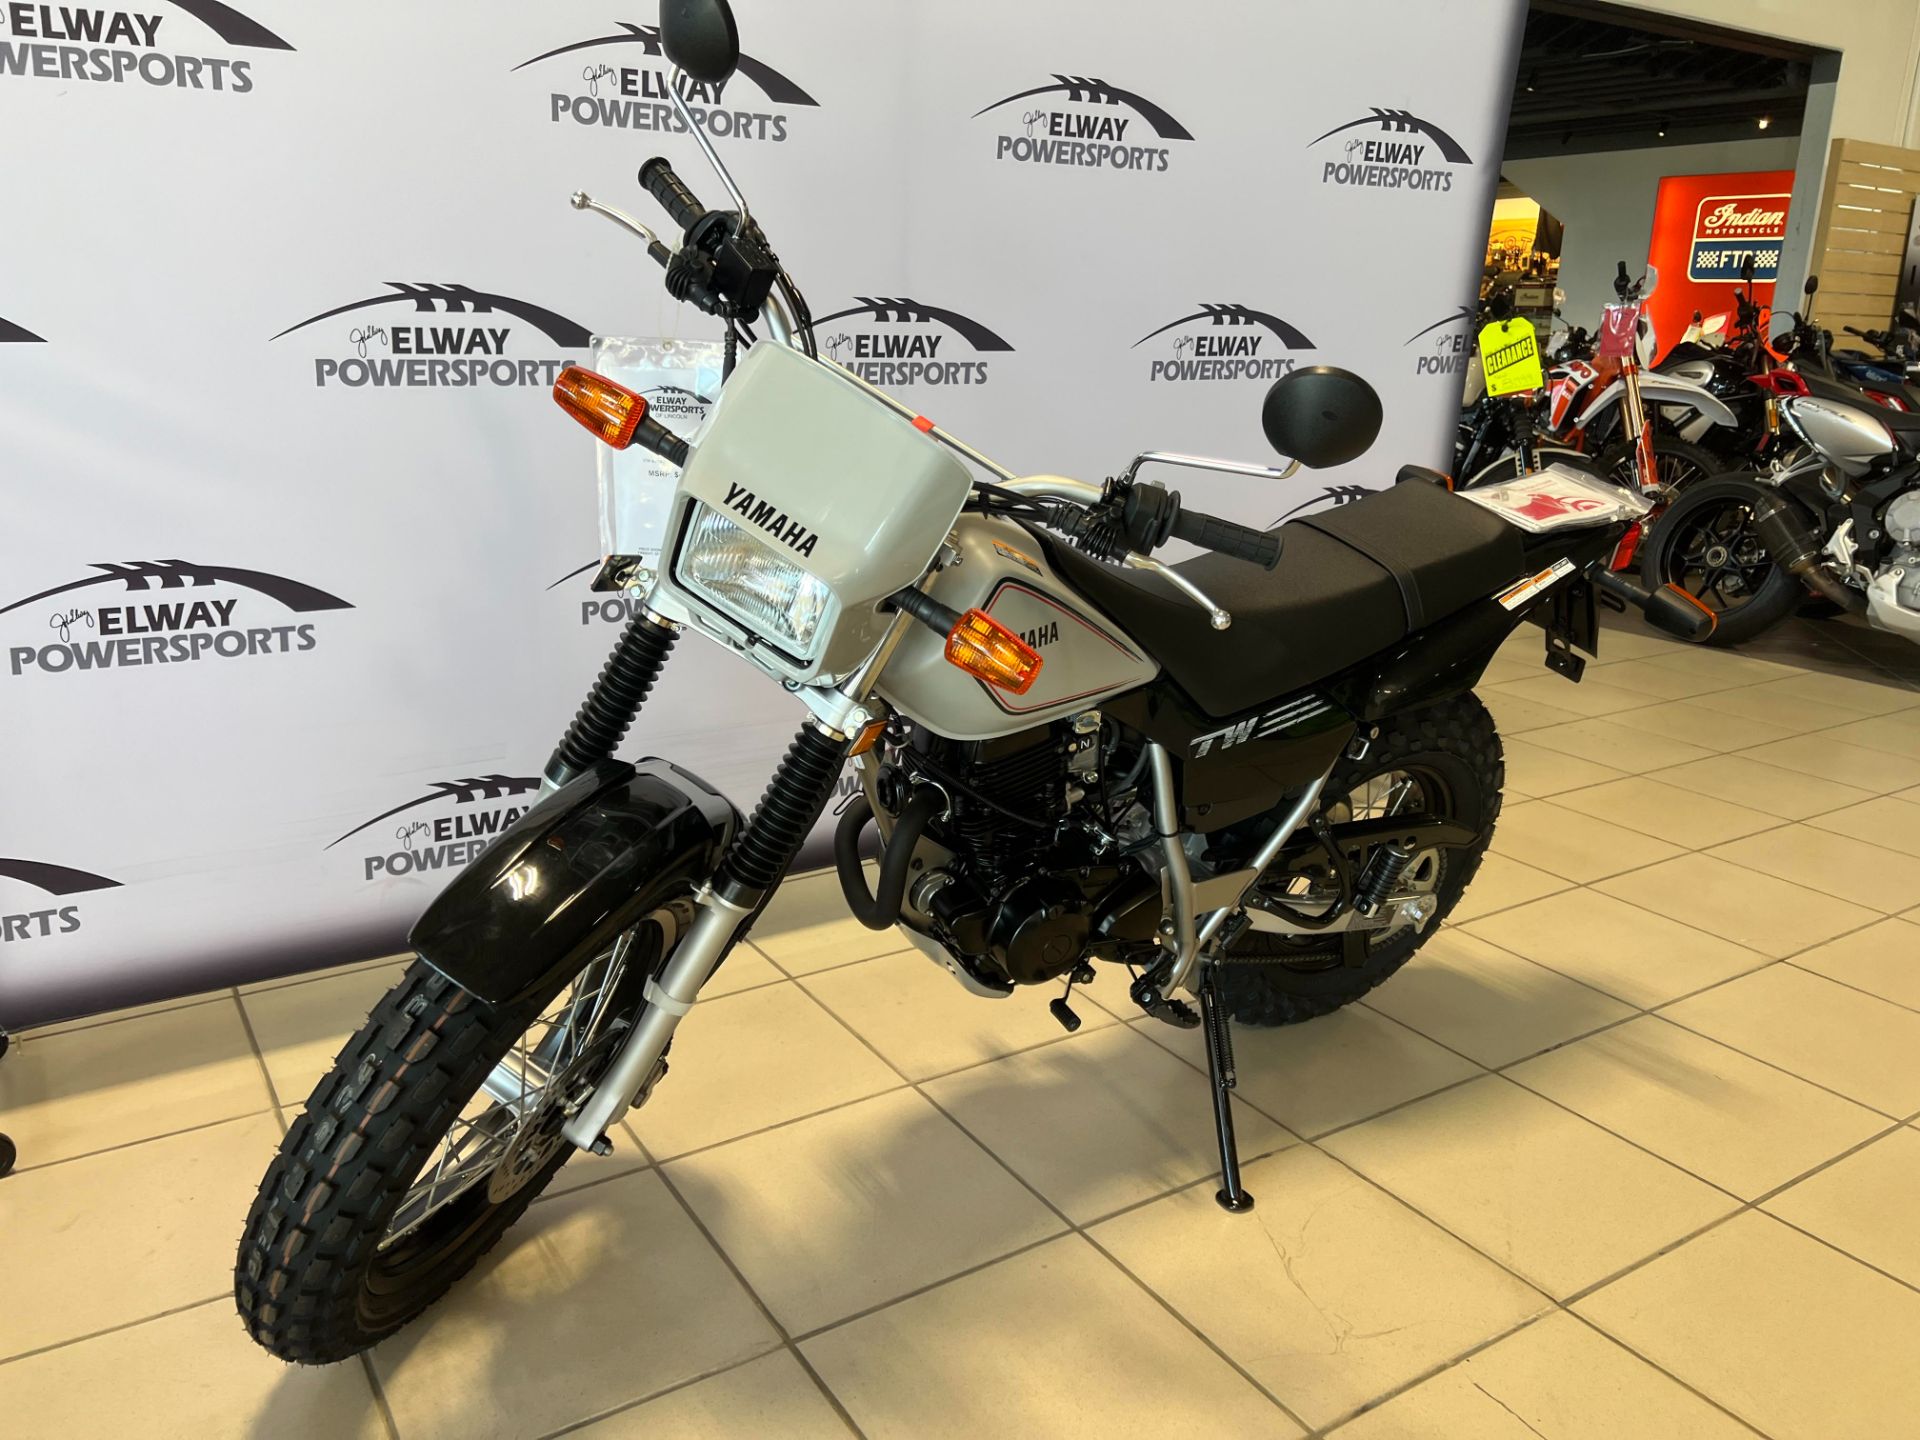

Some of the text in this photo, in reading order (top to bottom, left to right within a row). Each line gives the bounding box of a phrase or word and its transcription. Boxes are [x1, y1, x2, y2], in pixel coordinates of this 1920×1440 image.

[9, 2, 163, 47] ELWAY
[551, 93, 787, 142] POWERSPORTS
[1049, 112, 1129, 141] ELWAY
[997, 135, 1169, 172] POWERSPORTS
[1364, 141, 1424, 165] ELWAY
[1323, 162, 1453, 192] POWERSPORTS
[1704, 203, 1785, 228] Indian
[1705, 227, 1779, 235] MOTORCYCLE
[391, 326, 511, 355] ELWAY
[855, 334, 942, 358] ELWAY
[1195, 336, 1263, 356] ELWAY
[1150, 358, 1295, 381] POWERSPORTS
[1486, 338, 1533, 374] CLEARANCE
[315, 358, 577, 387] POWERSPORT
[656, 396, 687, 405] ELWAY
[722, 481, 819, 558] YAMAHA
[98, 599, 238, 635] ELWAY
[10, 624, 316, 675] POWERSPORTS
[1190, 716, 1259, 759] TW
[433, 805, 530, 842] ELWA
[364, 836, 499, 880] POWER
